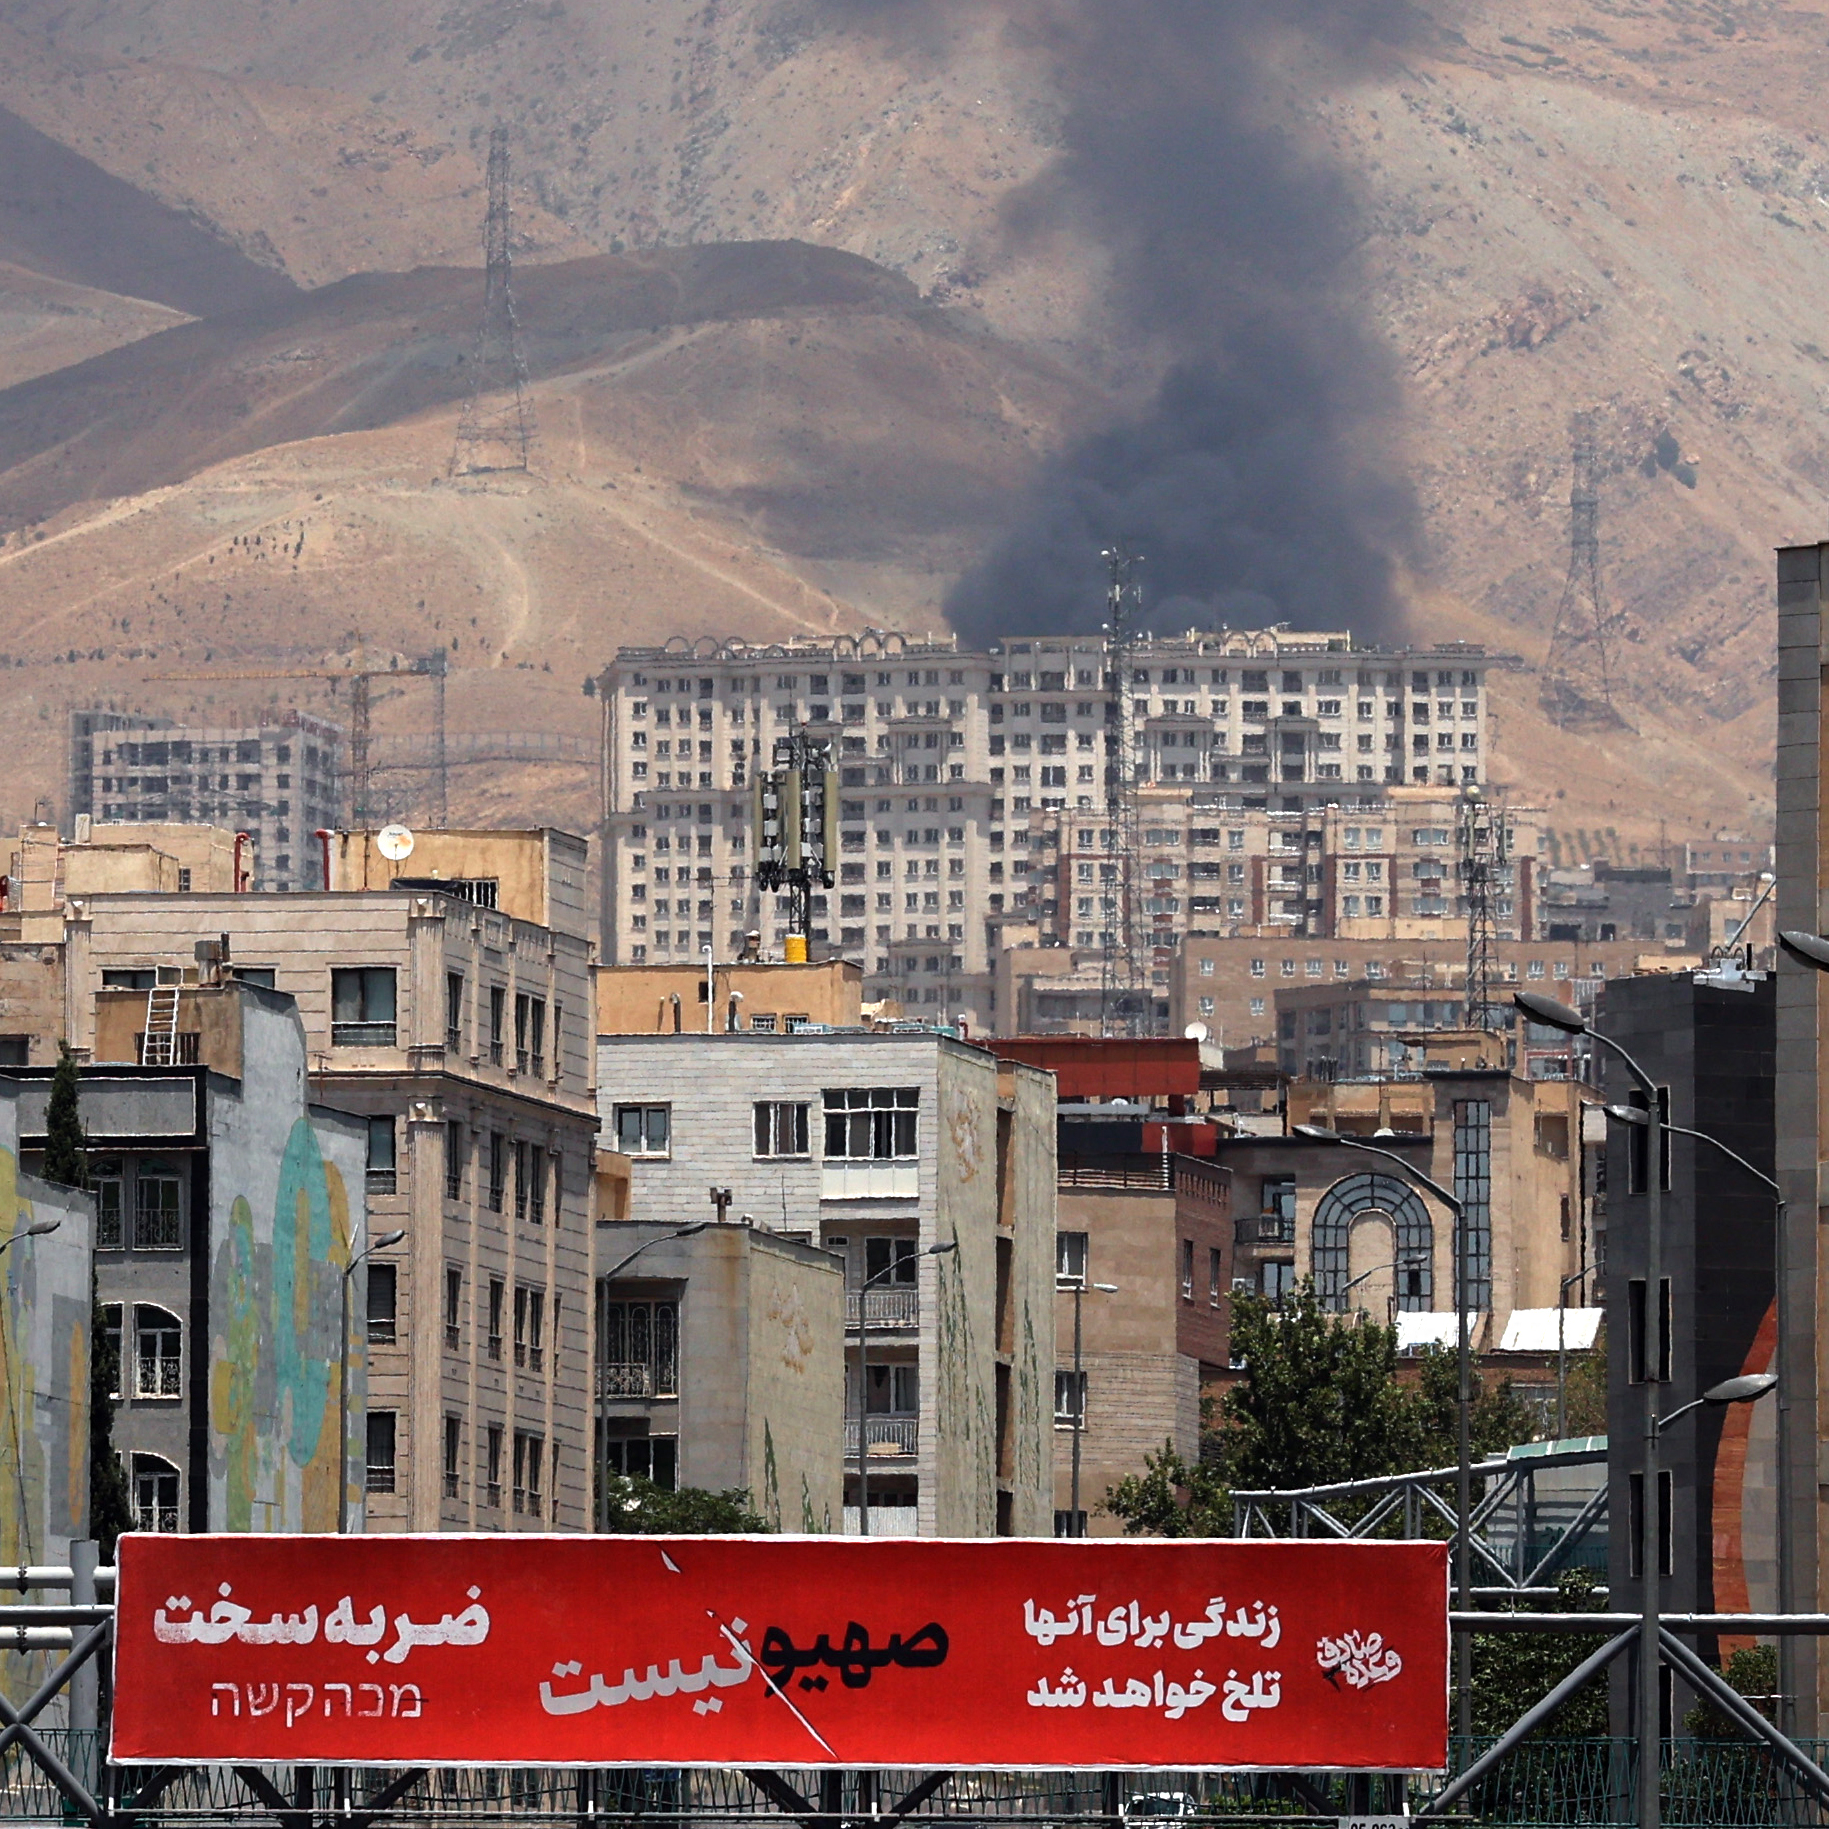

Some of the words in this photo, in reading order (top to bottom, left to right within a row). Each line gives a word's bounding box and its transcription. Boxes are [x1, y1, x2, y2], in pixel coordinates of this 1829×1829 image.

[1023, 1594, 1097, 1646] آنها
[1096, 1599, 1171, 1649] برای
[1173, 1596, 1281, 1650] زندگی
[211, 1682, 314, 1728] קשה
[1026, 1667, 1087, 1708] شد
[1092, 1668, 1217, 1720] خواهد
[1221, 1668, 1282, 1723] تلخ
